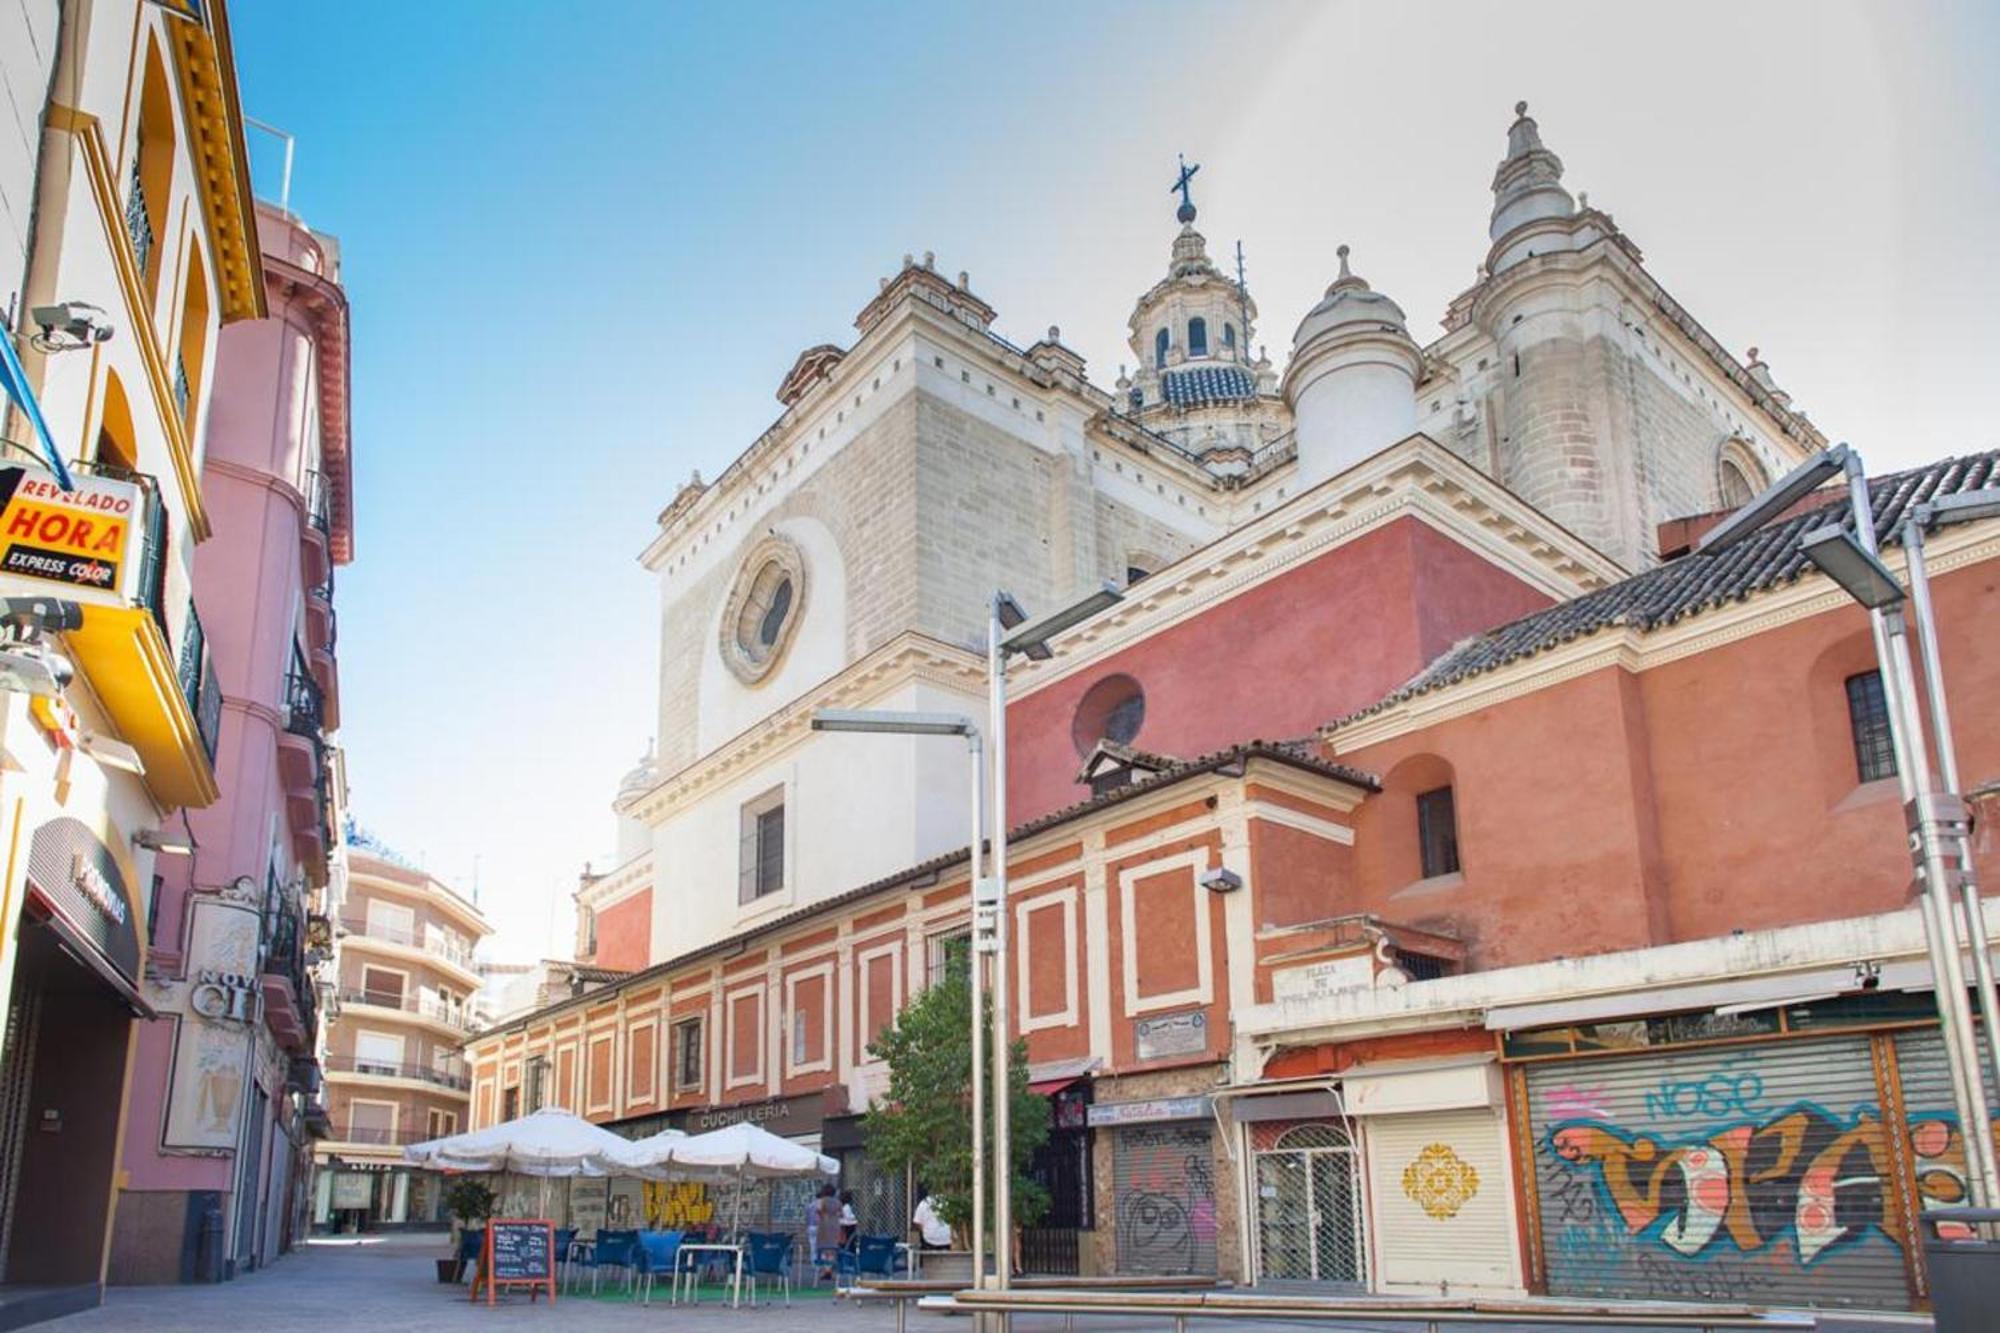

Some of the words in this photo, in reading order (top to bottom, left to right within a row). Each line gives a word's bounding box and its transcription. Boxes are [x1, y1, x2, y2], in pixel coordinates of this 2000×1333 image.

[7, 508, 121, 554] HORA
[8, 552, 67, 574] EXPRESS
[69, 562, 112, 582] COLOR
